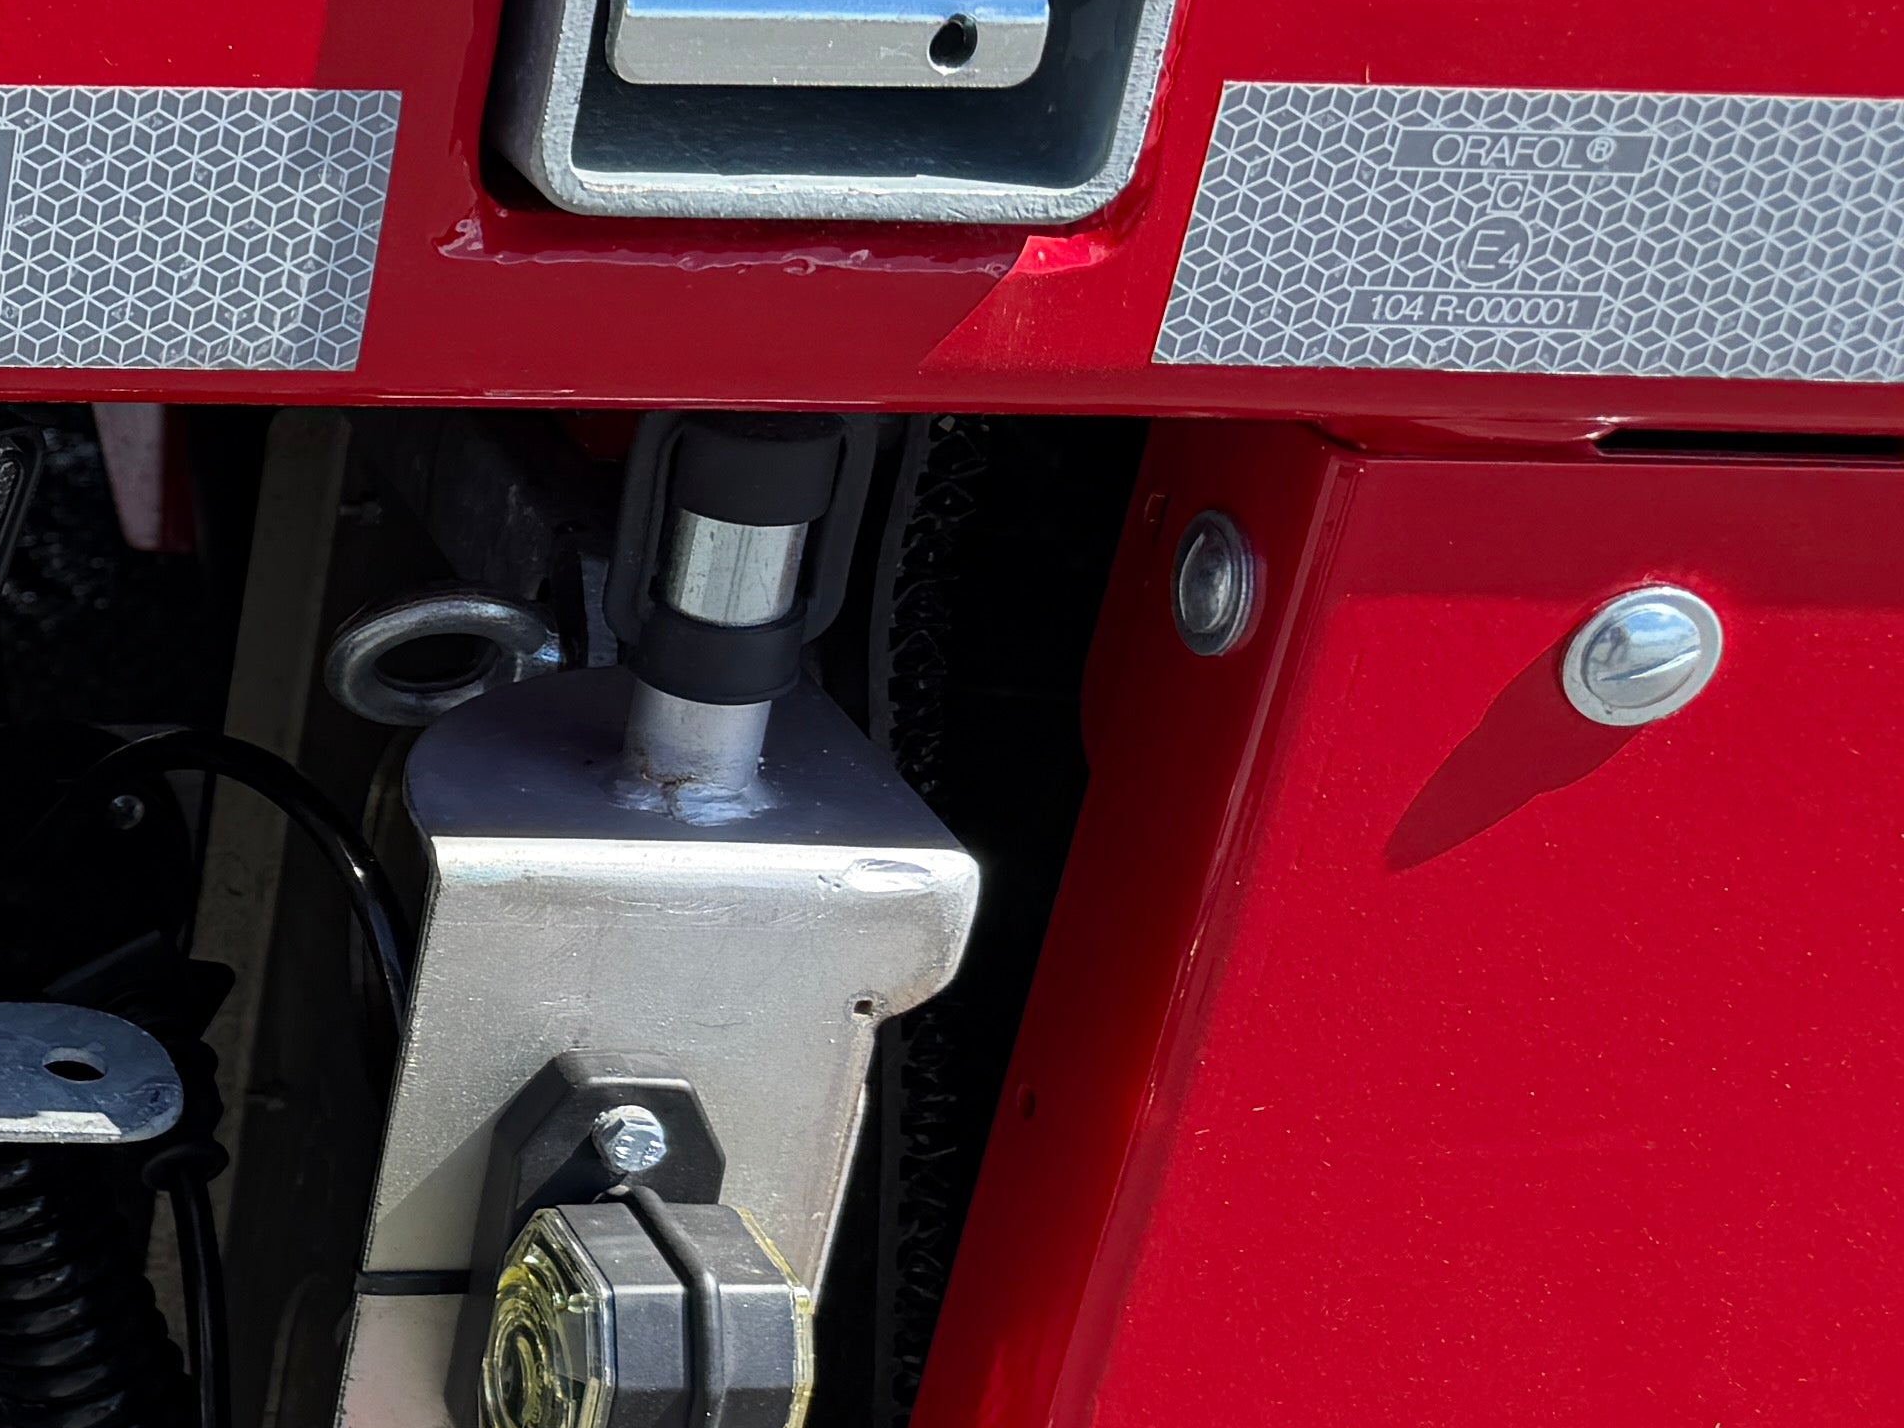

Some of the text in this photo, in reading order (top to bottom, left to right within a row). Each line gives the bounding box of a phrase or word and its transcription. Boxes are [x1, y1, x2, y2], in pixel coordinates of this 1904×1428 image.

[1496, 180, 1523, 209] C
[1371, 294, 1580, 325] 104 R-000001
